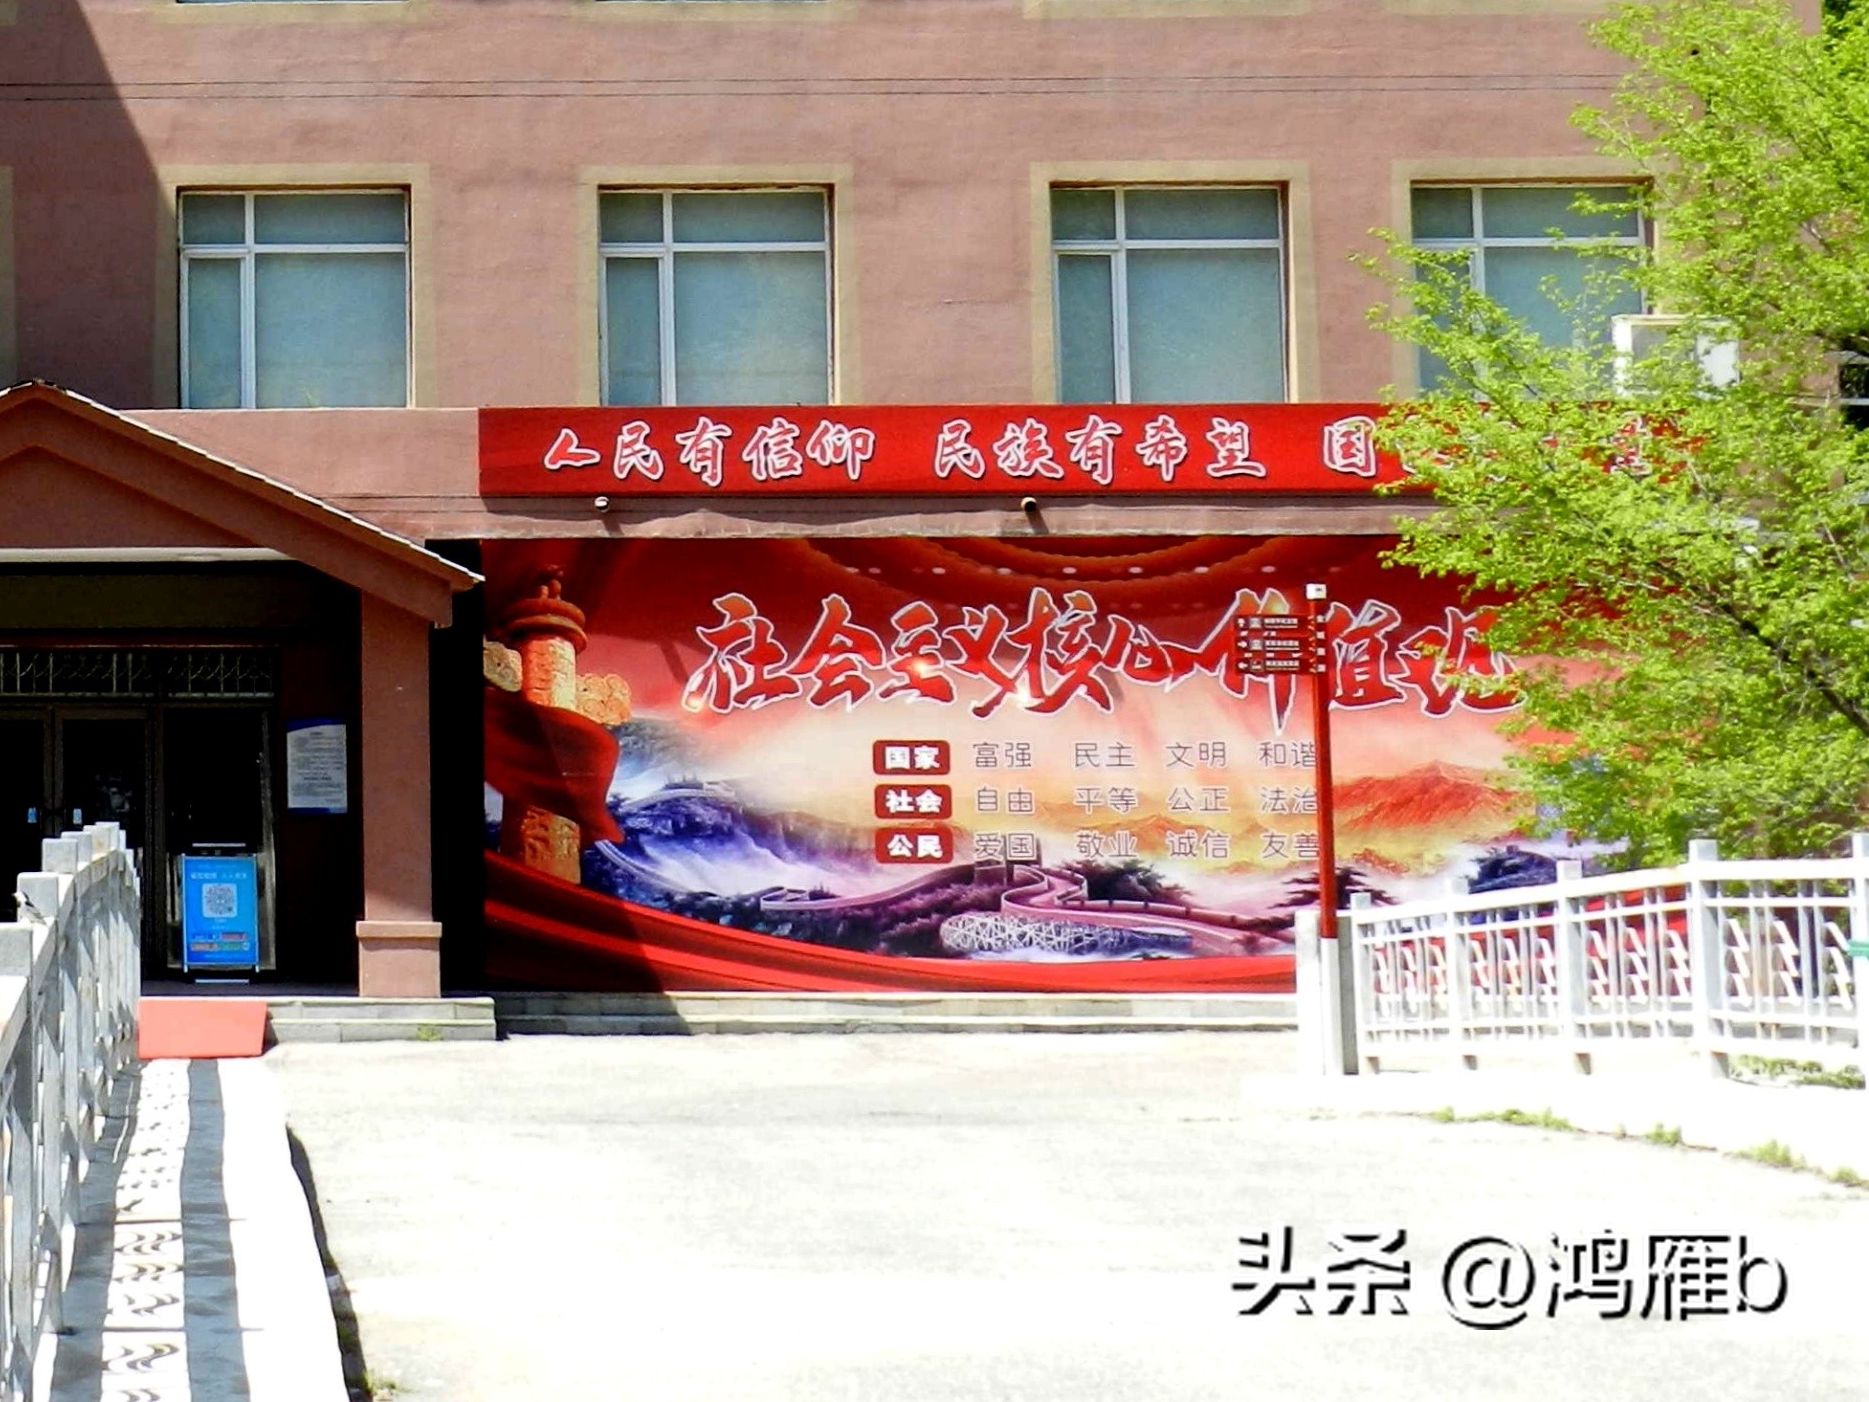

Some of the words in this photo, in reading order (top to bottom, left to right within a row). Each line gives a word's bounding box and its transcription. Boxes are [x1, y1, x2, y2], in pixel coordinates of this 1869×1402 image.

[542, 416, 877, 487] 人民有信仰
[933, 413, 1268, 487] 民族有希望
[883, 744, 941, 771] 国家
[971, 740, 1033, 769] 富强
[1073, 740, 1136, 769] 民主
[1165, 740, 1228, 769] 文明
[1257, 740, 1317, 769] 和谐
[885, 788, 943, 814] 社会
[976, 785, 1035, 815] 自由
[1074, 785, 1139, 815] 平等
[1167, 785, 1231, 815] 公正
[1259, 785, 1318, 815] 法治
[886, 834, 944, 860] 公民
[974, 831, 1037, 861] 爱国
[1075, 831, 1139, 861] 敬业
[1167, 831, 1230, 861] 诚信
[1261, 831, 1320, 861] 友善
